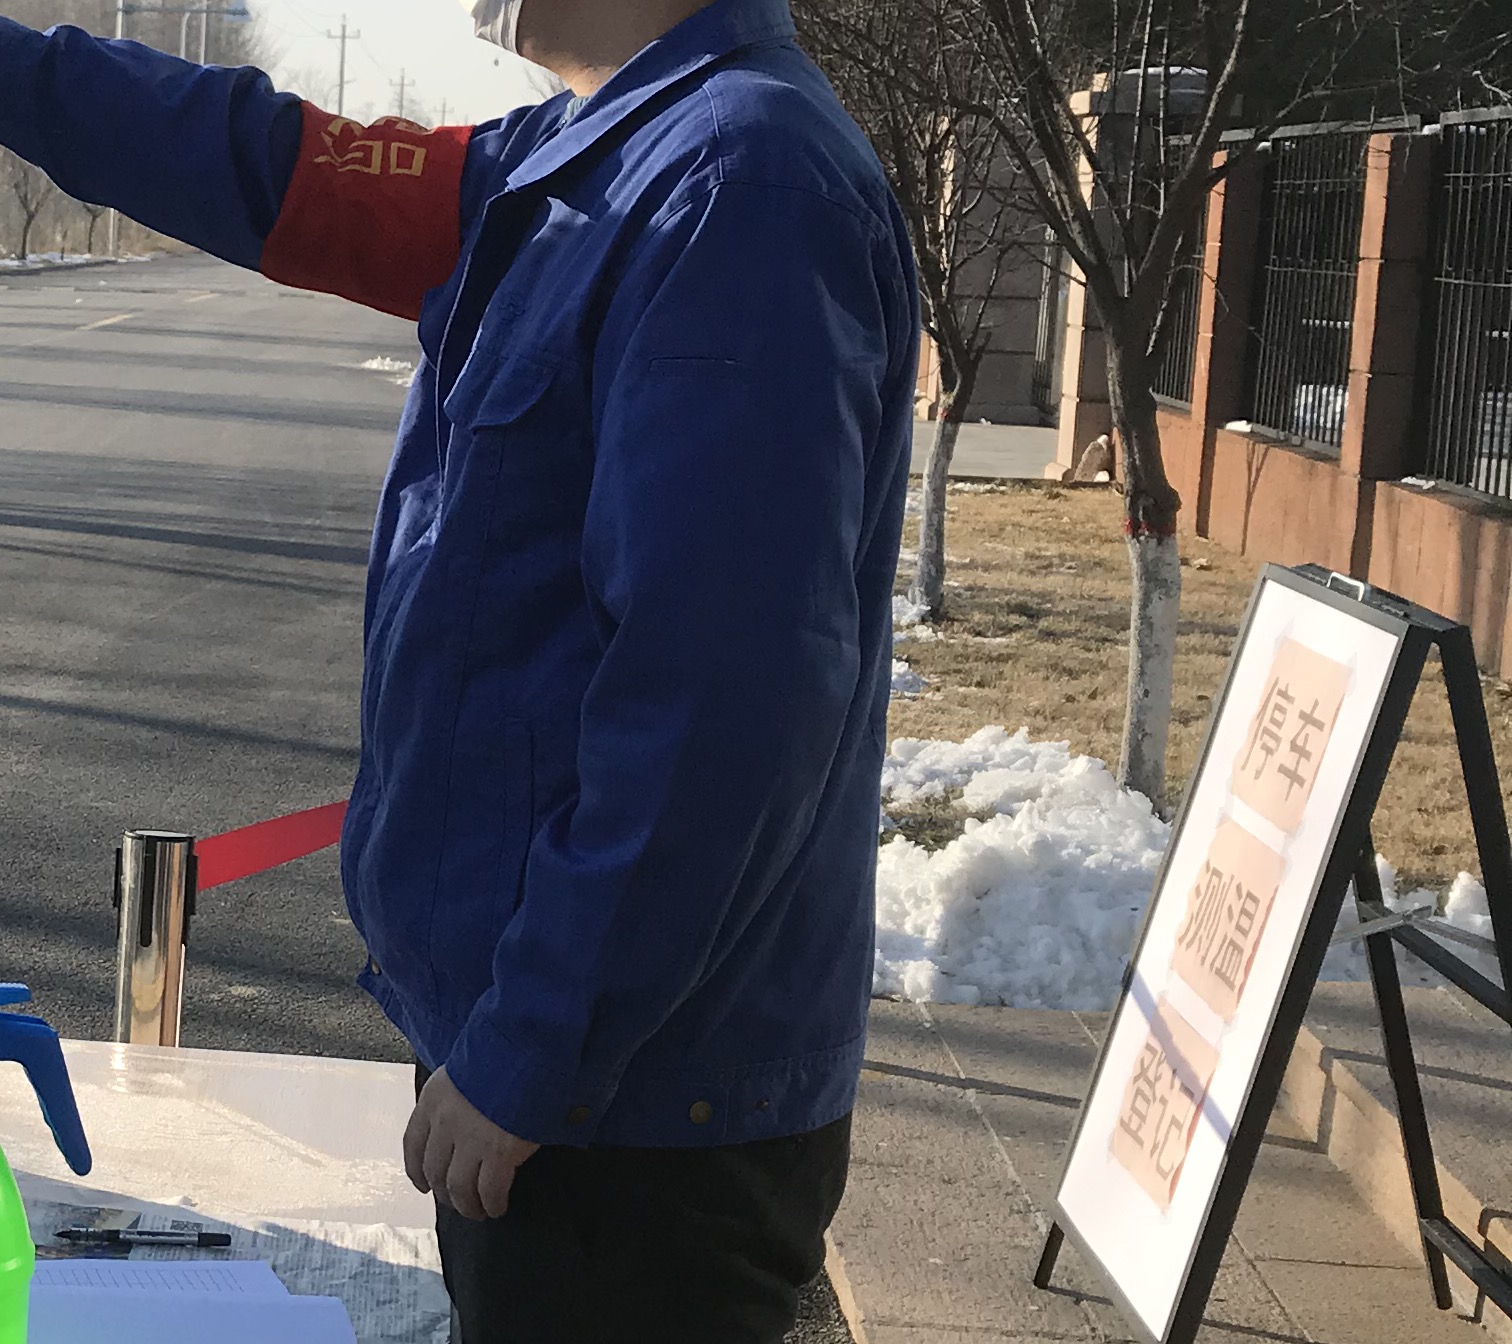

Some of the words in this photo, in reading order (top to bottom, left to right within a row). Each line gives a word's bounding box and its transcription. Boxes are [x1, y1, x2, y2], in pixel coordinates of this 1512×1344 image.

[1242, 677, 1326, 801] 停车
[1179, 861, 1260, 993] 测温
[1120, 1044, 1195, 1179] 登记
